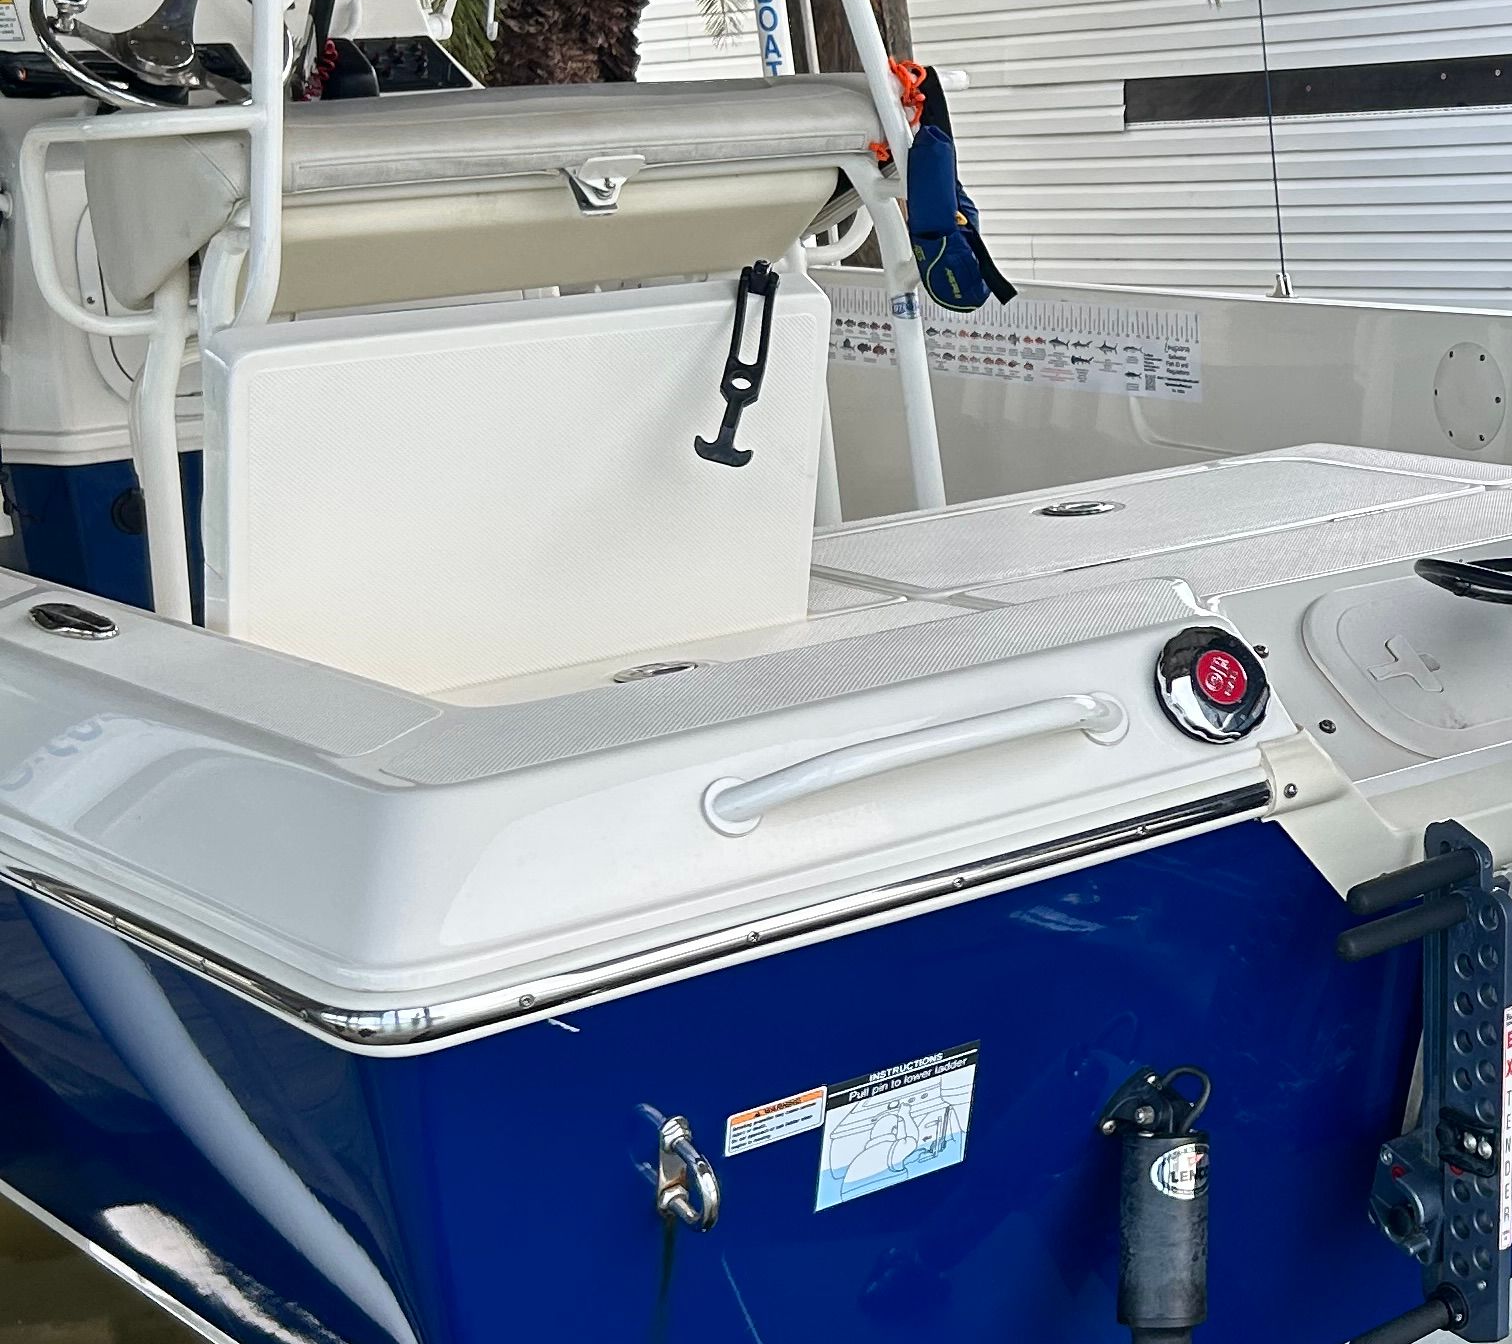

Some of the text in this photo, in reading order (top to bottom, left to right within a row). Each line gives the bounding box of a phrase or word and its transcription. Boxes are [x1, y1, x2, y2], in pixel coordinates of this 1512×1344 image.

[848, 1057, 968, 1102] Pull pin to lower ladder
[868, 1052, 944, 1082] INSTRUCTIONS
